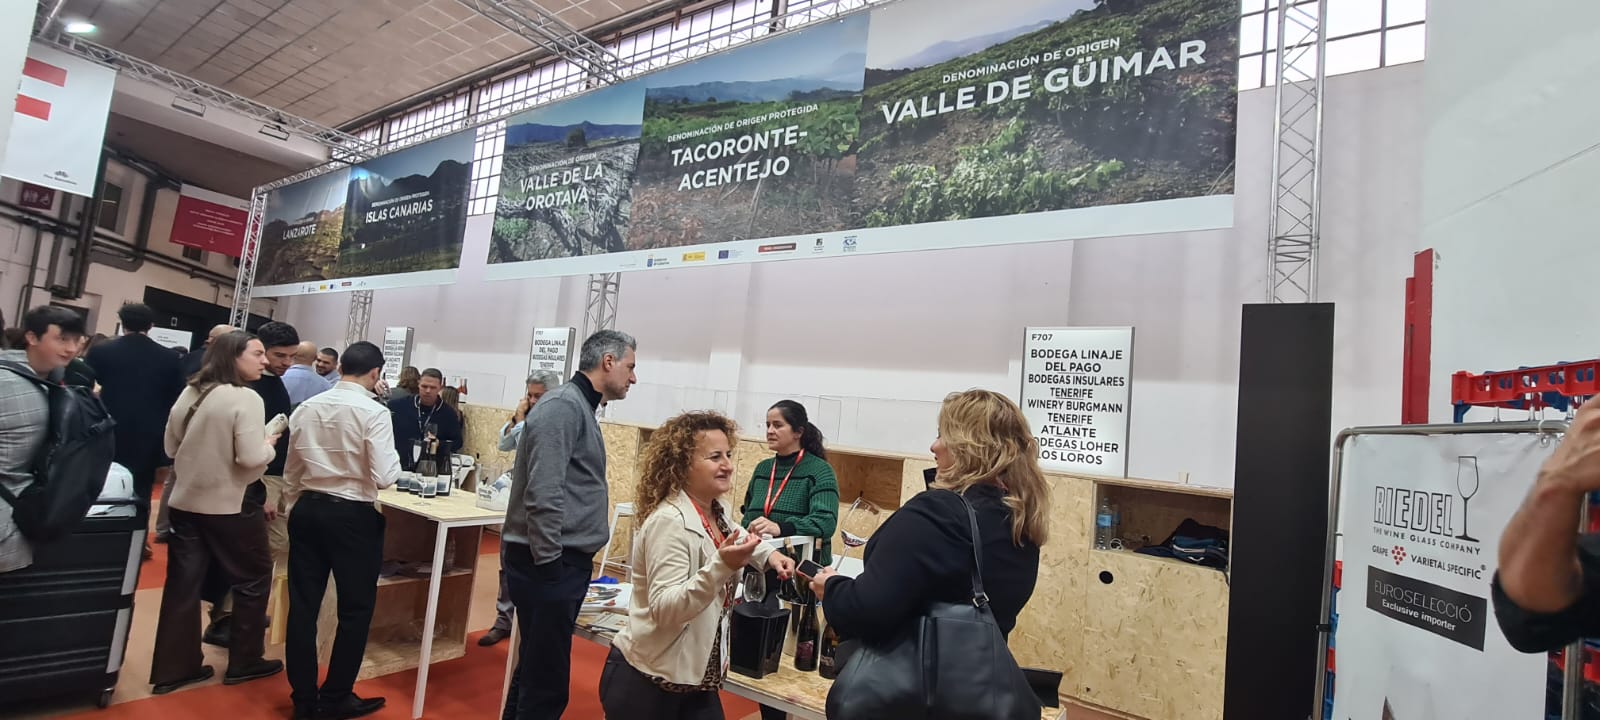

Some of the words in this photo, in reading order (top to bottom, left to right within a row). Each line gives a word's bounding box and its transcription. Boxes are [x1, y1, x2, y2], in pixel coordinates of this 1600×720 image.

[942, 55, 1039, 84] DENOMINACIÓN
[1043, 50, 1062, 62] DE
[1065, 37, 1121, 56] ORIGEN
[882, 85, 976, 124] VALLE
[986, 75, 1032, 105] DE
[1044, 39, 1207, 93] GÜIMAR
[667, 124, 723, 143] DENOMINACIÓN
[724, 121, 735, 129] DE
[736, 114, 767, 128] ORIGEN
[768, 103, 819, 121] PROTEGIDA
[671, 125, 808, 167] TACORONTE-
[567, 156, 575, 164] DE
[575, 152, 597, 162] ORIGEN
[520, 172, 559, 193] VALLE
[562, 167, 581, 185] DE
[584, 163, 603, 181] LA
[678, 156, 790, 191] ACENTEJO
[526, 186, 588, 211] OROTAVA
[365, 208, 388, 224] ISLAS
[389, 199, 433, 219] CANARIAS
[283, 223, 317, 240] LANZAROTE
[1031, 333, 1053, 341] F707
[1030, 349, 1078, 359] BODEGA
[1081, 350, 1122, 360] LINAJE
[1045, 362, 1066, 372] DEL
[1069, 363, 1101, 373] PAGO
[1028, 374, 1071, 385] BODEGAS
[1072, 375, 1125, 387] INSULARES
[1050, 387, 1094, 399] TENERIFE
[1027, 399, 1064, 410] WINERY
[1066, 401, 1123, 413] BURGMANN
[1048, 412, 1093, 425] TENERIFE
[1041, 425, 1096, 438] ATLANTE
[1034, 437, 1077, 450] DEGAS
[1080, 441, 1119, 453] LOHER
[1060, 451, 1103, 465] LOROS
[1374, 486, 1453, 537] RIEDEL
[1383, 529, 1405, 540] WINE
[1410, 534, 1436, 546] GLASS
[1440, 540, 1480, 555] COMPANY
[1411, 554, 1446, 568] VARIETAL
[1375, 580, 1472, 623] EUROSELECCIÓ
[1382, 599, 1419, 618] Exclusive
[1421, 611, 1456, 631] importer
